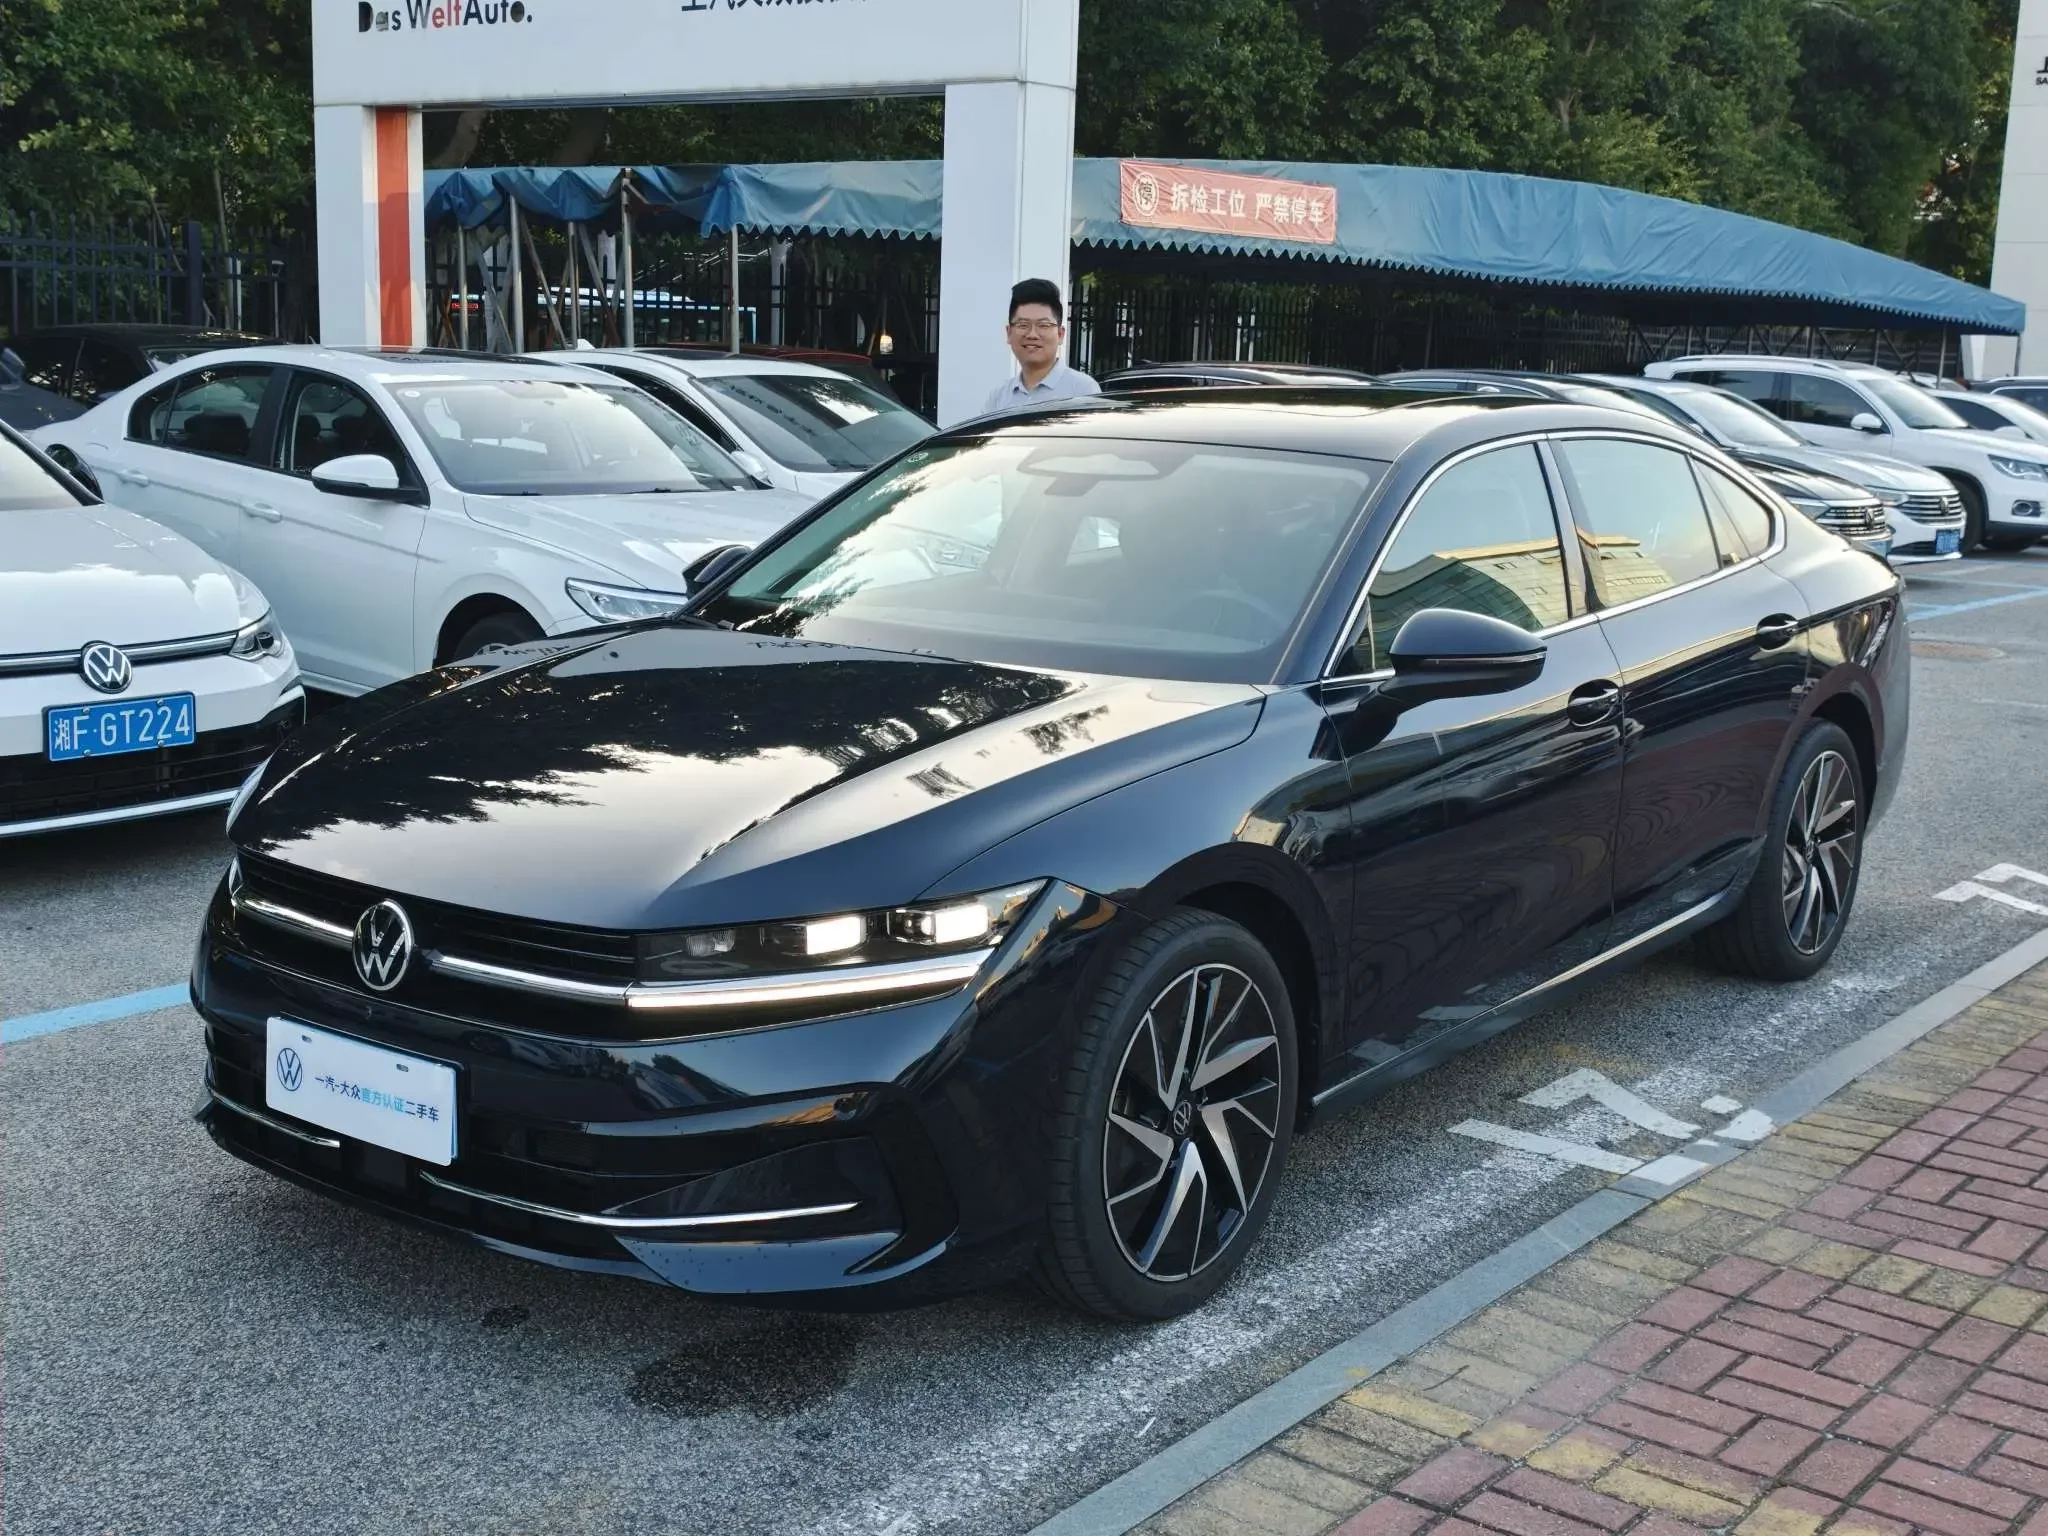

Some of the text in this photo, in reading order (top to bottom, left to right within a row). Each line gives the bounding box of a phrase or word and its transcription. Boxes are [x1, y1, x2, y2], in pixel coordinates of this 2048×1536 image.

[358, 1, 401, 33] Das
[1170, 182, 1325, 228] 拆检工位 严禁停车
